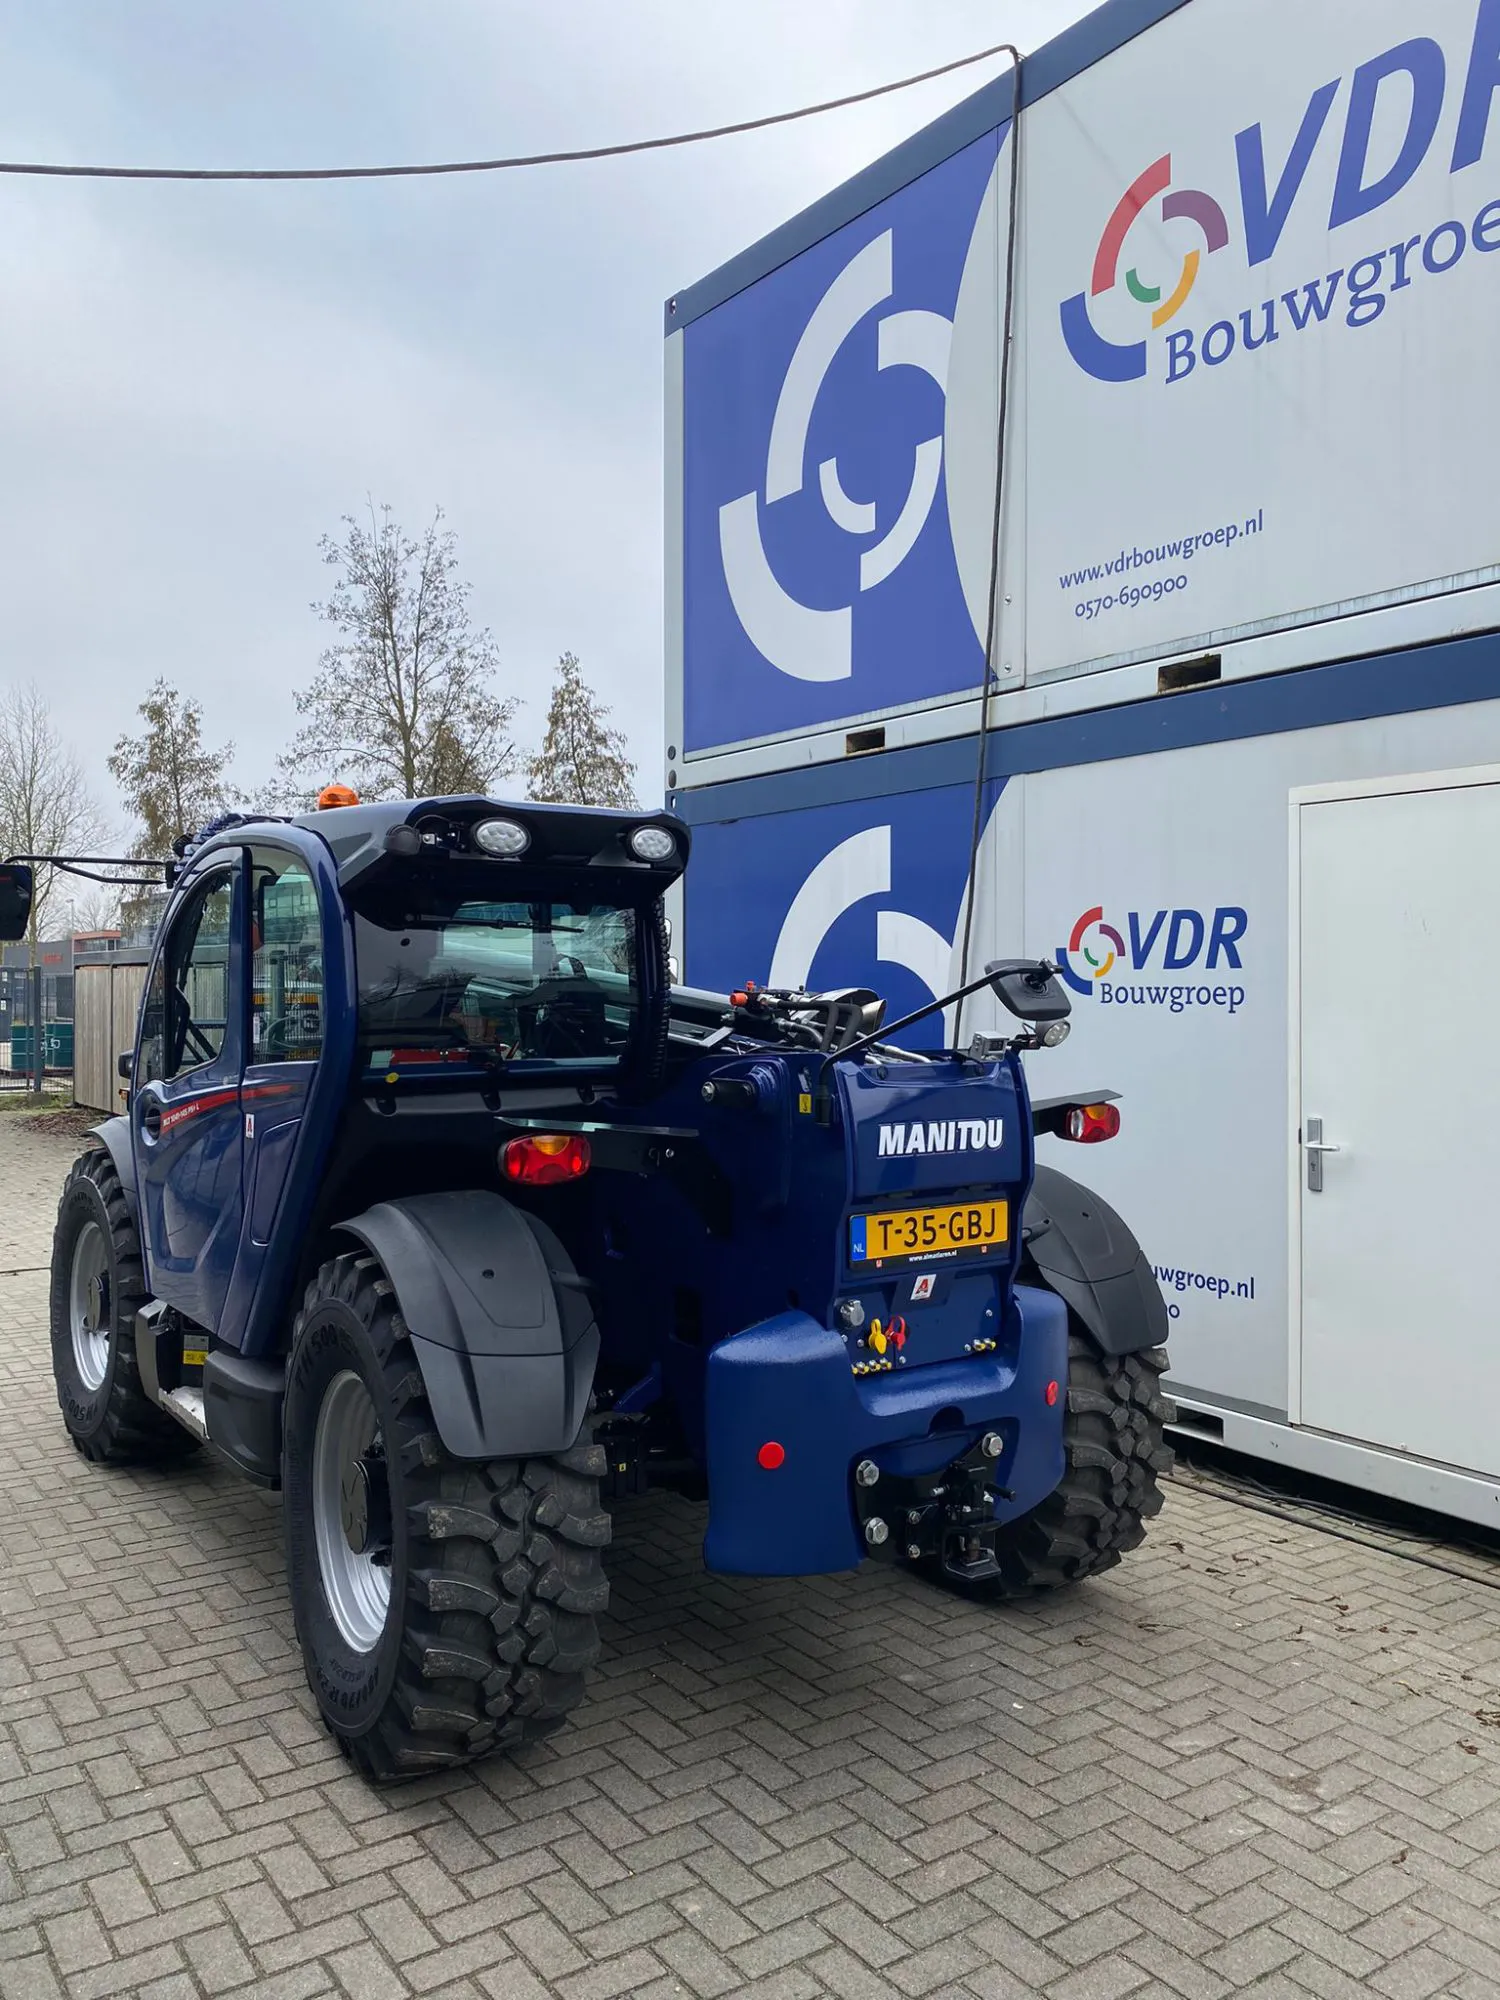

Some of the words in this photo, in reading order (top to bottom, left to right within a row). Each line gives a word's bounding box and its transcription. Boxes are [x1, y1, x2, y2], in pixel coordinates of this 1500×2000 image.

[1059, 509, 1263, 589] www.vdrbouwgroep.nl
[1075, 575, 1187, 620] 0570-690900
[1128, 907, 1248, 970] VDR
[1100, 983, 1245, 1014] Bouwgroep
[878, 1118, 1003, 1156] MANITOU
[853, 1244, 864, 1253] NL
[878, 1208, 996, 1250] T-35-GBJ
